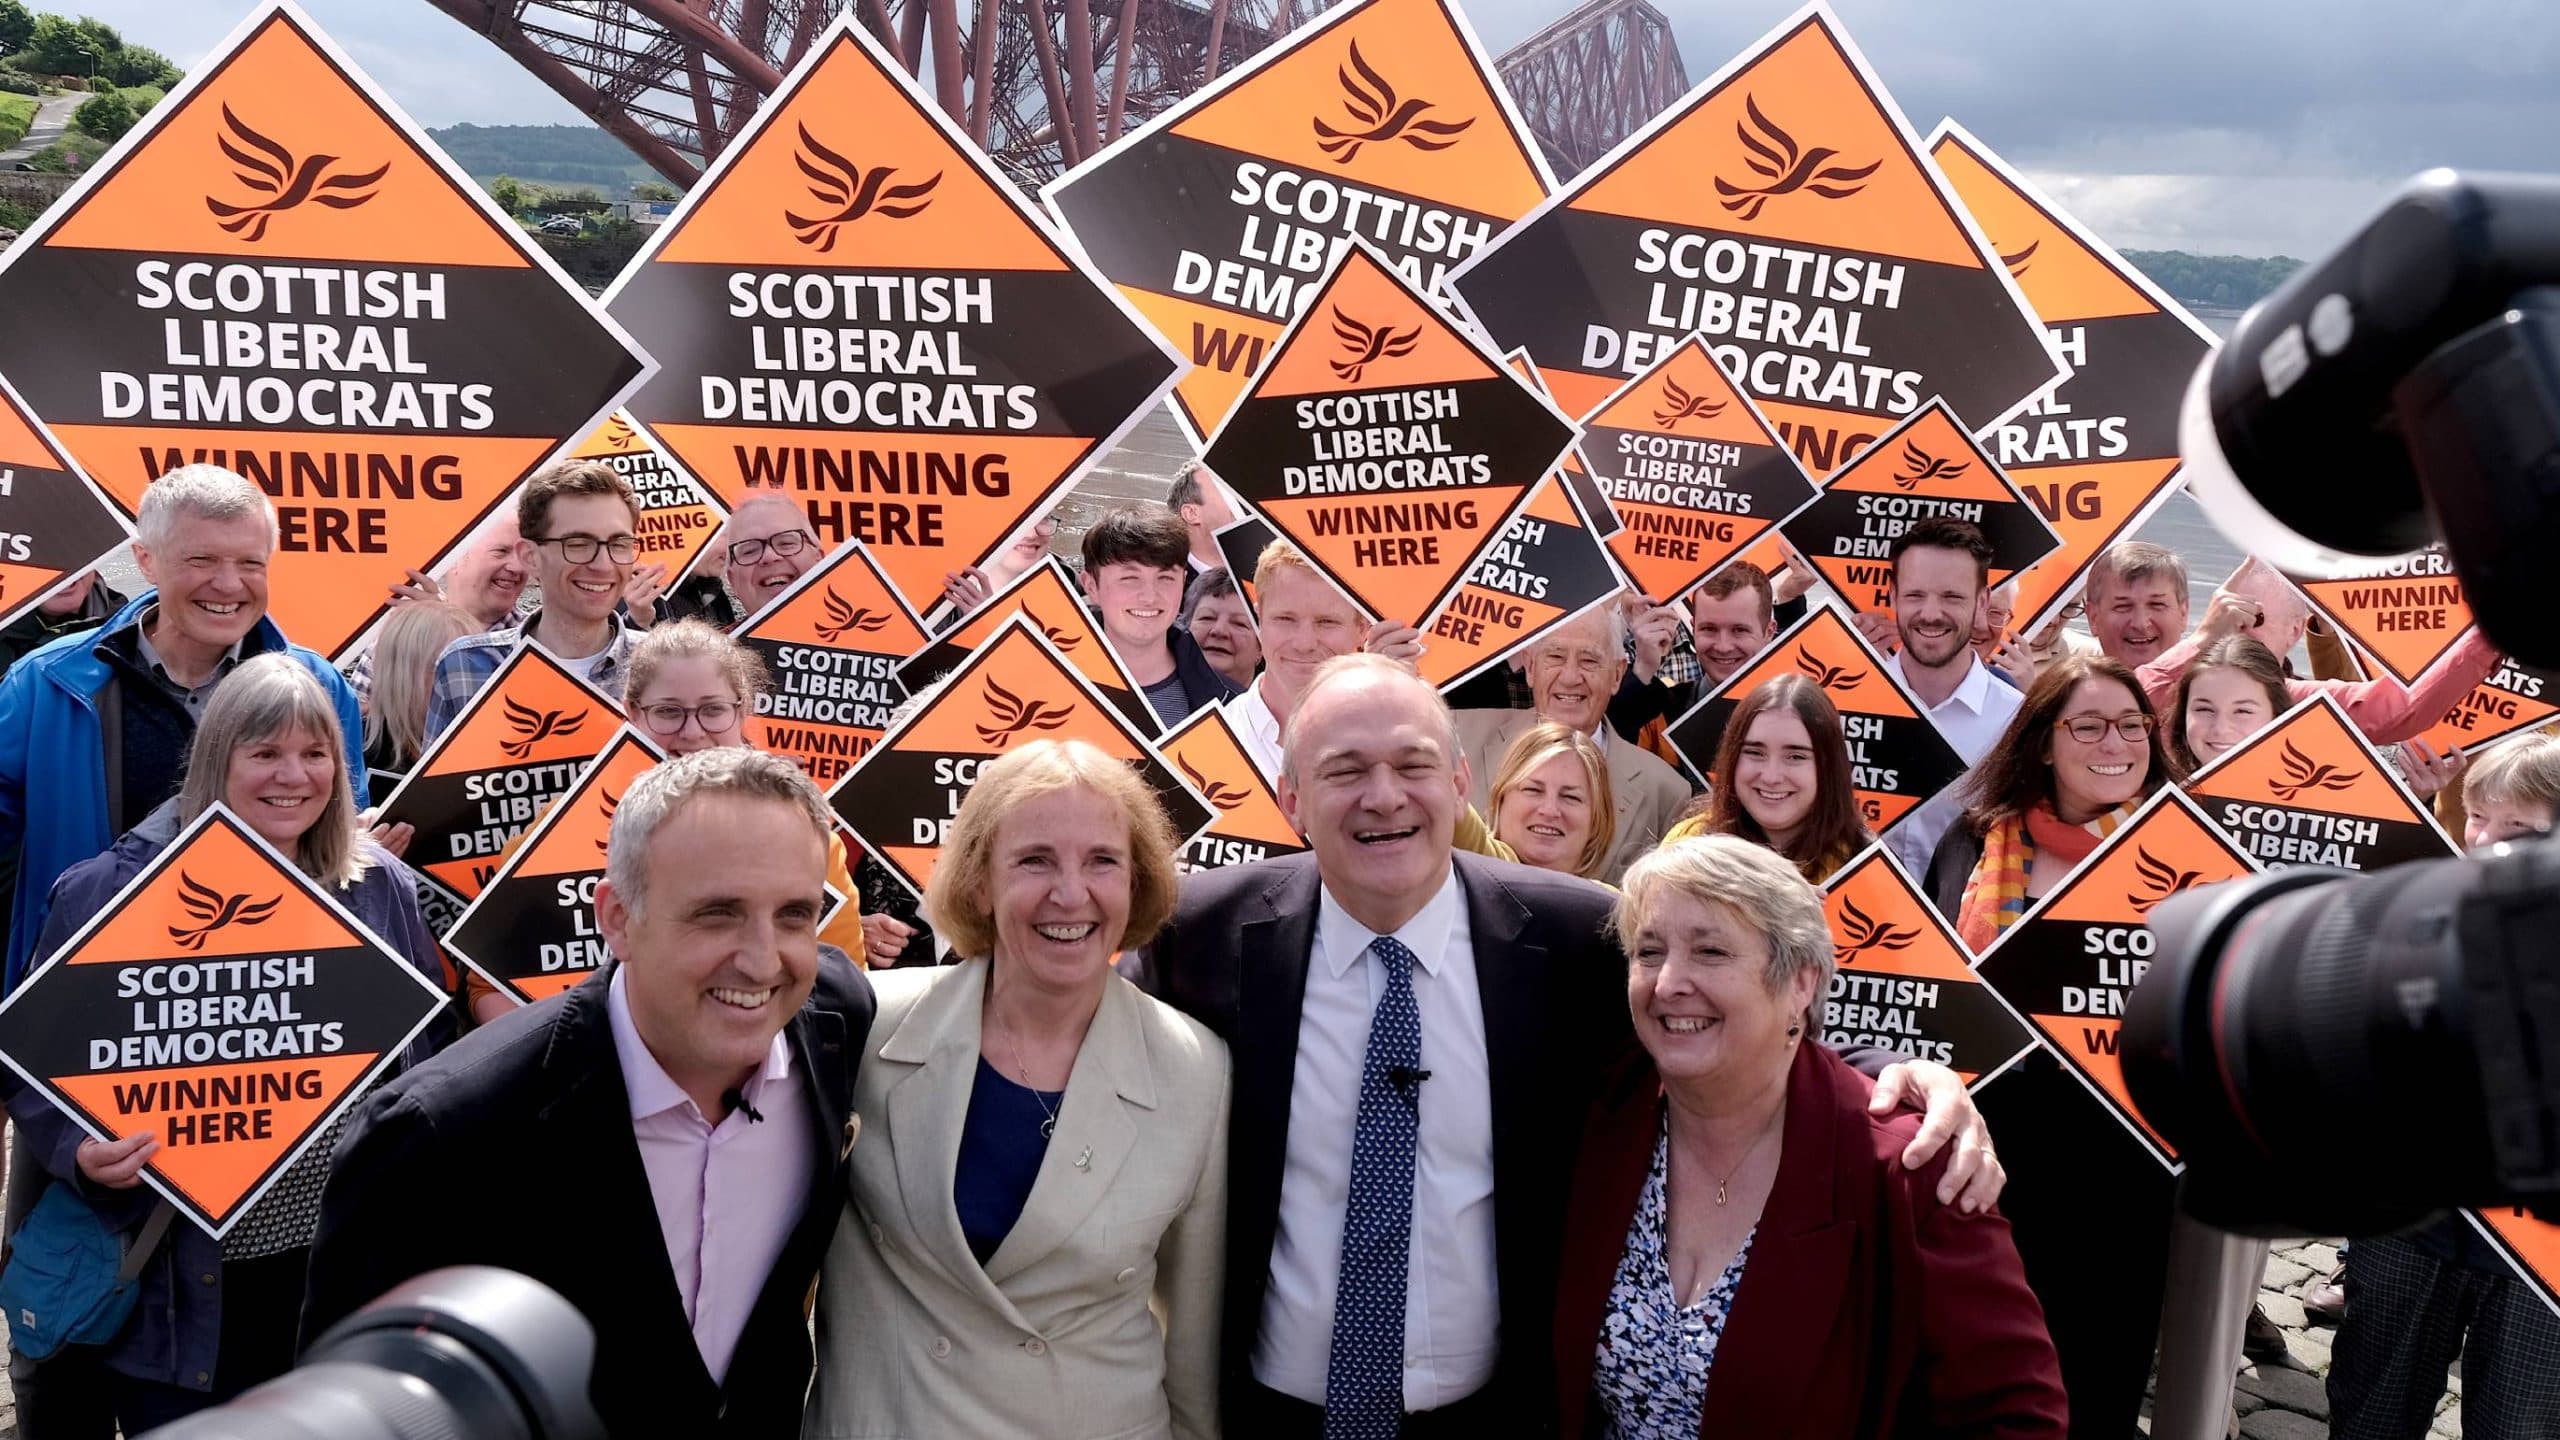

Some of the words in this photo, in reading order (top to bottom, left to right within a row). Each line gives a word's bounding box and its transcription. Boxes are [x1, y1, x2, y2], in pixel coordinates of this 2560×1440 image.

[1230, 162, 1491, 260] SCOTTISH
[1239, 215, 1455, 309] LIBAL
[1634, 228, 1906, 311] SCOTTISH
[135, 260, 446, 320] SCOTTISH
[728, 272, 993, 324] SCOTTISH
[1645, 281, 1873, 358] LIBERAL
[164, 318, 427, 375] LIBERAL
[751, 326, 977, 377] LIBERAL
[100, 371, 494, 430] DEMOCRATS
[701, 376, 1038, 430] DEMOCRATS
[1297, 388, 1459, 429] SCOTTISH
[1312, 424, 1451, 460] LIBERAL
[1618, 433, 1741, 466] SCOTTISH
[734, 445, 1010, 498] WINNING
[1283, 454, 1491, 495] DEMOCRATS
[1624, 457, 1727, 488] LIBERAL
[1598, 477, 1752, 514] DEMOCRATS
[1856, 495, 1983, 523] SCOTTISH
[278, 507, 388, 553] ERE
[634, 512, 708, 534] NNING
[807, 500, 945, 547] HERE
[1307, 501, 1478, 536] WINNING
[1353, 537, 1439, 567] HERE
[1634, 535, 1699, 562] HERE
[1449, 592, 1524, 629] NING
[2342, 584, 2459, 610] WINNIN
[1428, 614, 1485, 646] ERE
[2377, 609, 2446, 632] HERE
[784, 671, 893, 704] LIBERAL
[753, 692, 896, 728] DEMOCRA
[766, 726, 881, 757] WINNIN
[465, 760, 594, 800] SCOTTI
[799, 755, 857, 780] HER
[2222, 803, 2379, 846] SCOTTISH
[117, 956, 315, 998] SCOTTISH
[1829, 974, 1939, 1008] OTTISH
[133, 991, 302, 1032] LIBERAL
[1824, 1001, 1922, 1036] BERAL
[89, 1021, 344, 1070] DEMOCRATS
[1820, 1029, 1954, 1066] OCRATS
[112, 1069, 323, 1115] WINNING
[167, 1109, 273, 1148] HERE
